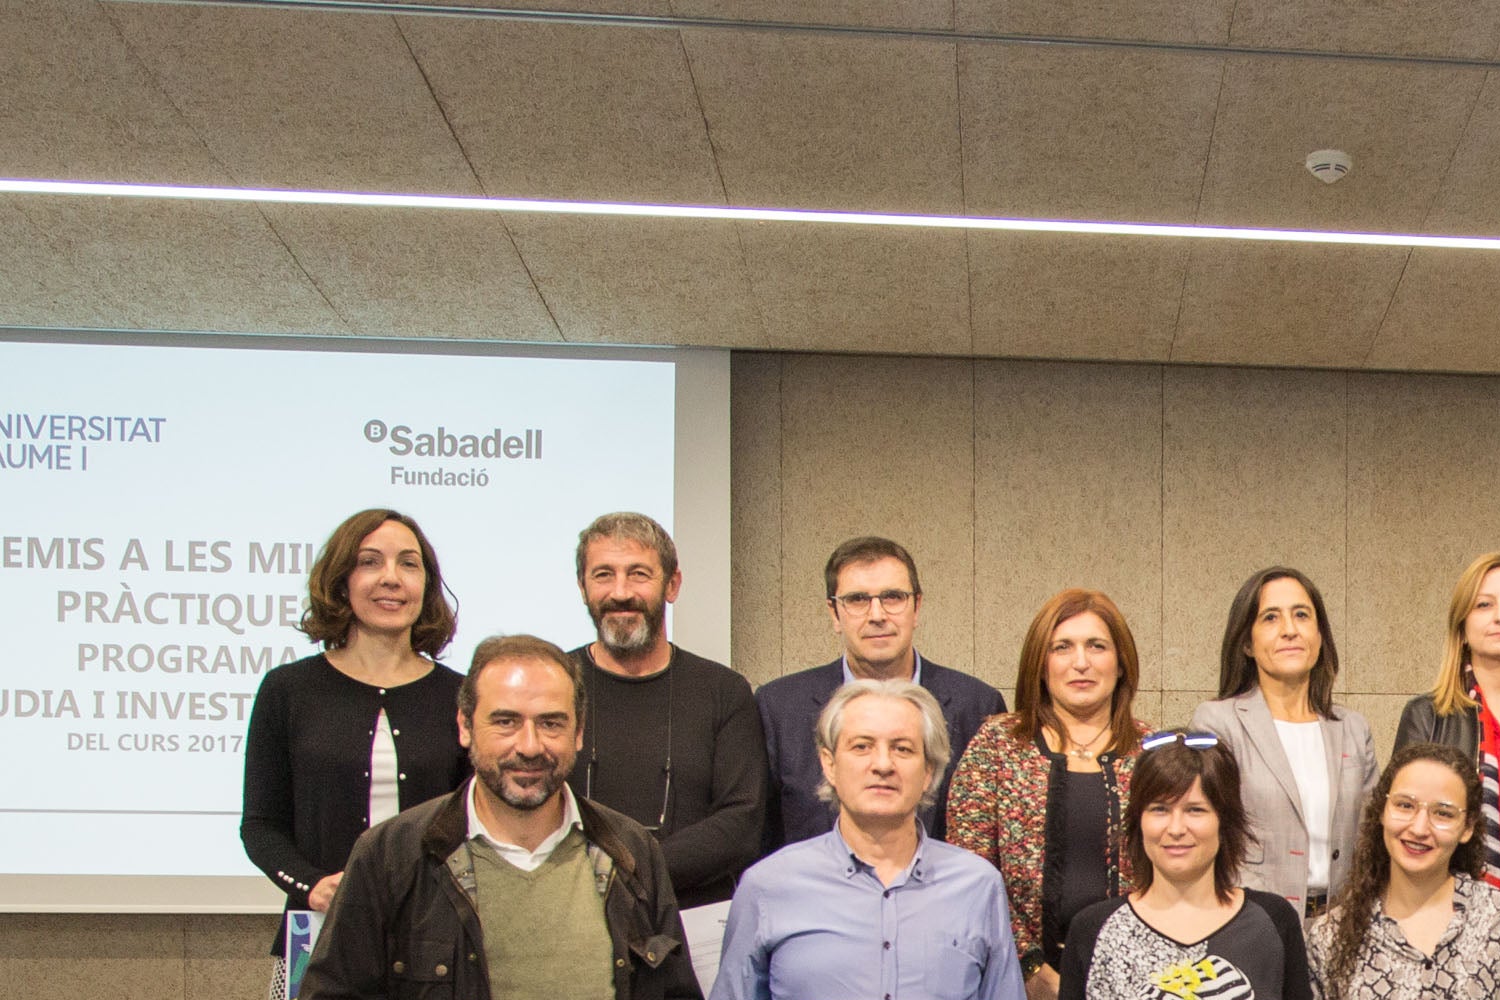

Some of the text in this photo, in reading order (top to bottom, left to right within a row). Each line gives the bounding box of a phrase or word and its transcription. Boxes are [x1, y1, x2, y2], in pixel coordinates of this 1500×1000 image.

[389, 425, 543, 459] Sabadell
[82, 446, 87, 471] I
[391, 466, 489, 487] Fundació
[119, 538, 150, 571] A
[165, 540, 233, 573] LES
[78, 643, 300, 674] PROGRAMA
[93, 690, 105, 719] I
[67, 732, 243, 753] DEL CURS 2017
